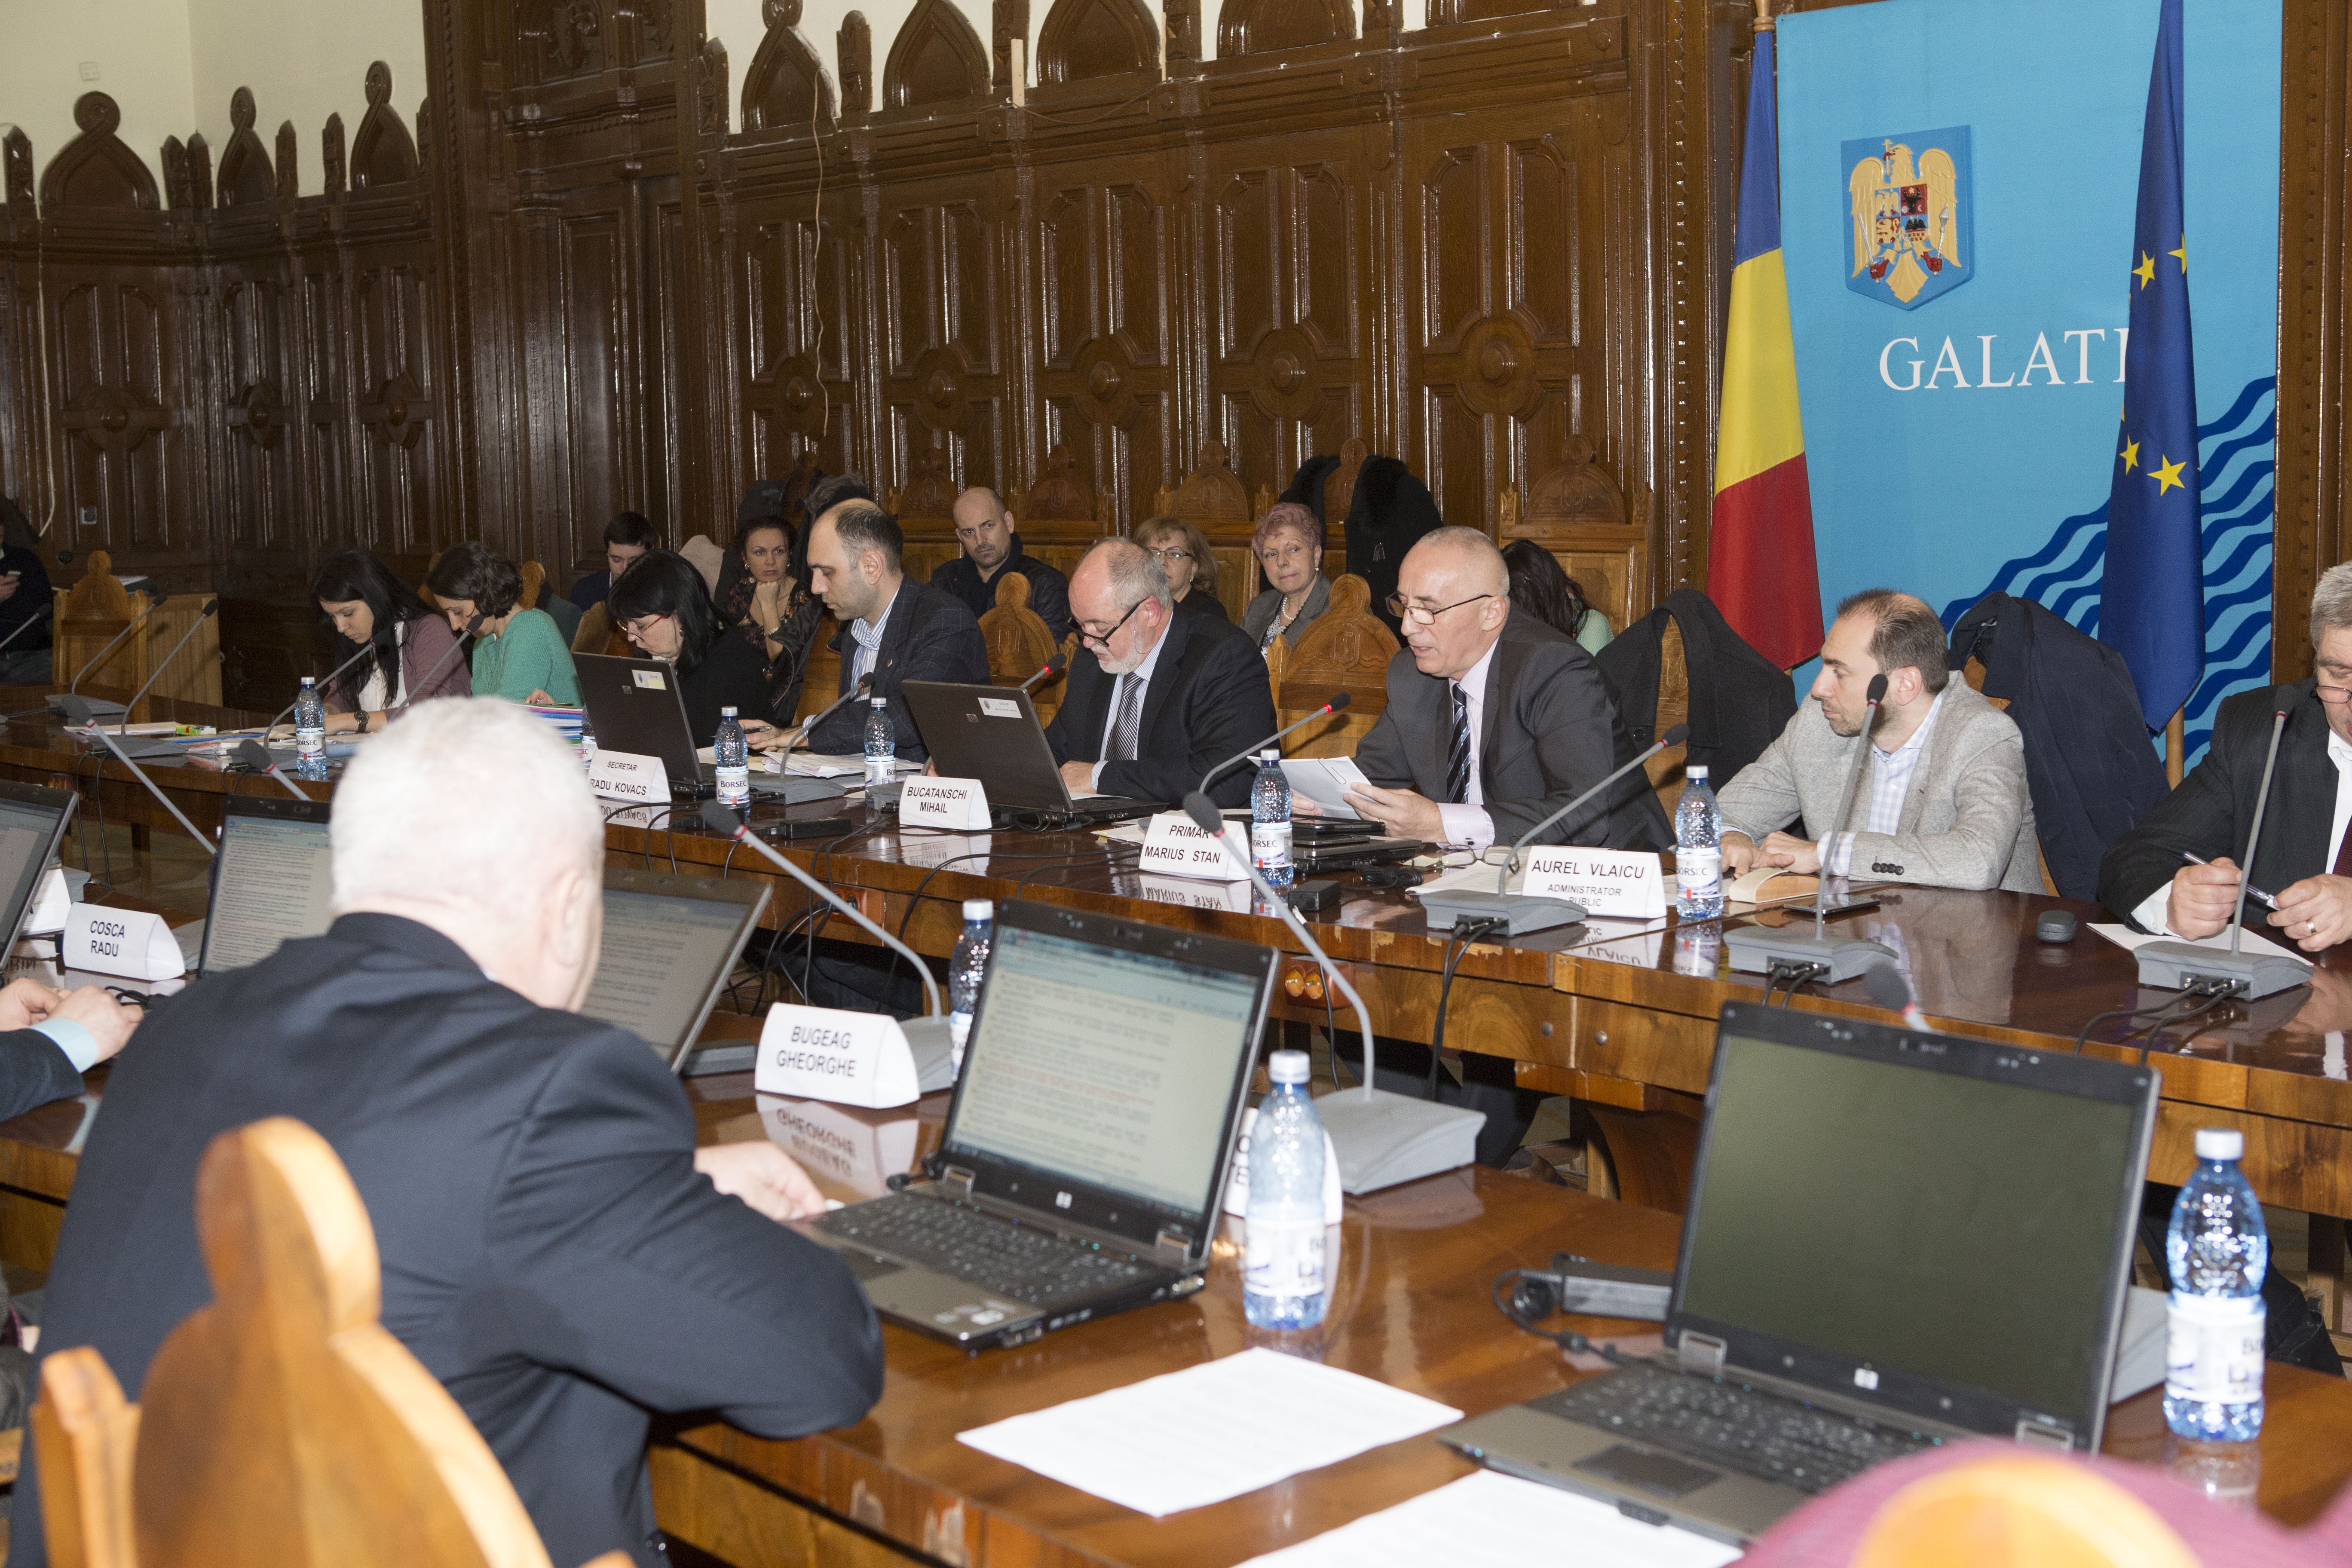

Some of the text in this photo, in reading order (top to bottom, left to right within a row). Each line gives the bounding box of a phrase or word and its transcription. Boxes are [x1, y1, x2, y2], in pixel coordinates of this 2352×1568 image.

[607, 761, 637, 772] SECRETAR
[589, 778, 646, 795] RADU KOVACS
[907, 787, 967, 799] BUCATANSCHI
[920, 802, 947, 813] MIHAIL
[1169, 825, 1209, 839] PRIMAR
[1145, 846, 1221, 864] MARIUS STAN
[1531, 860, 1645, 879] AUREL VLAICU
[1547, 884, 1622, 896] ADMINISTRATOR
[90, 920, 125, 938] COSCA
[91, 940, 119, 957] RADU
[791, 1026, 851, 1049] BUGEAG
[776, 1050, 856, 1077] GHEORGHE
